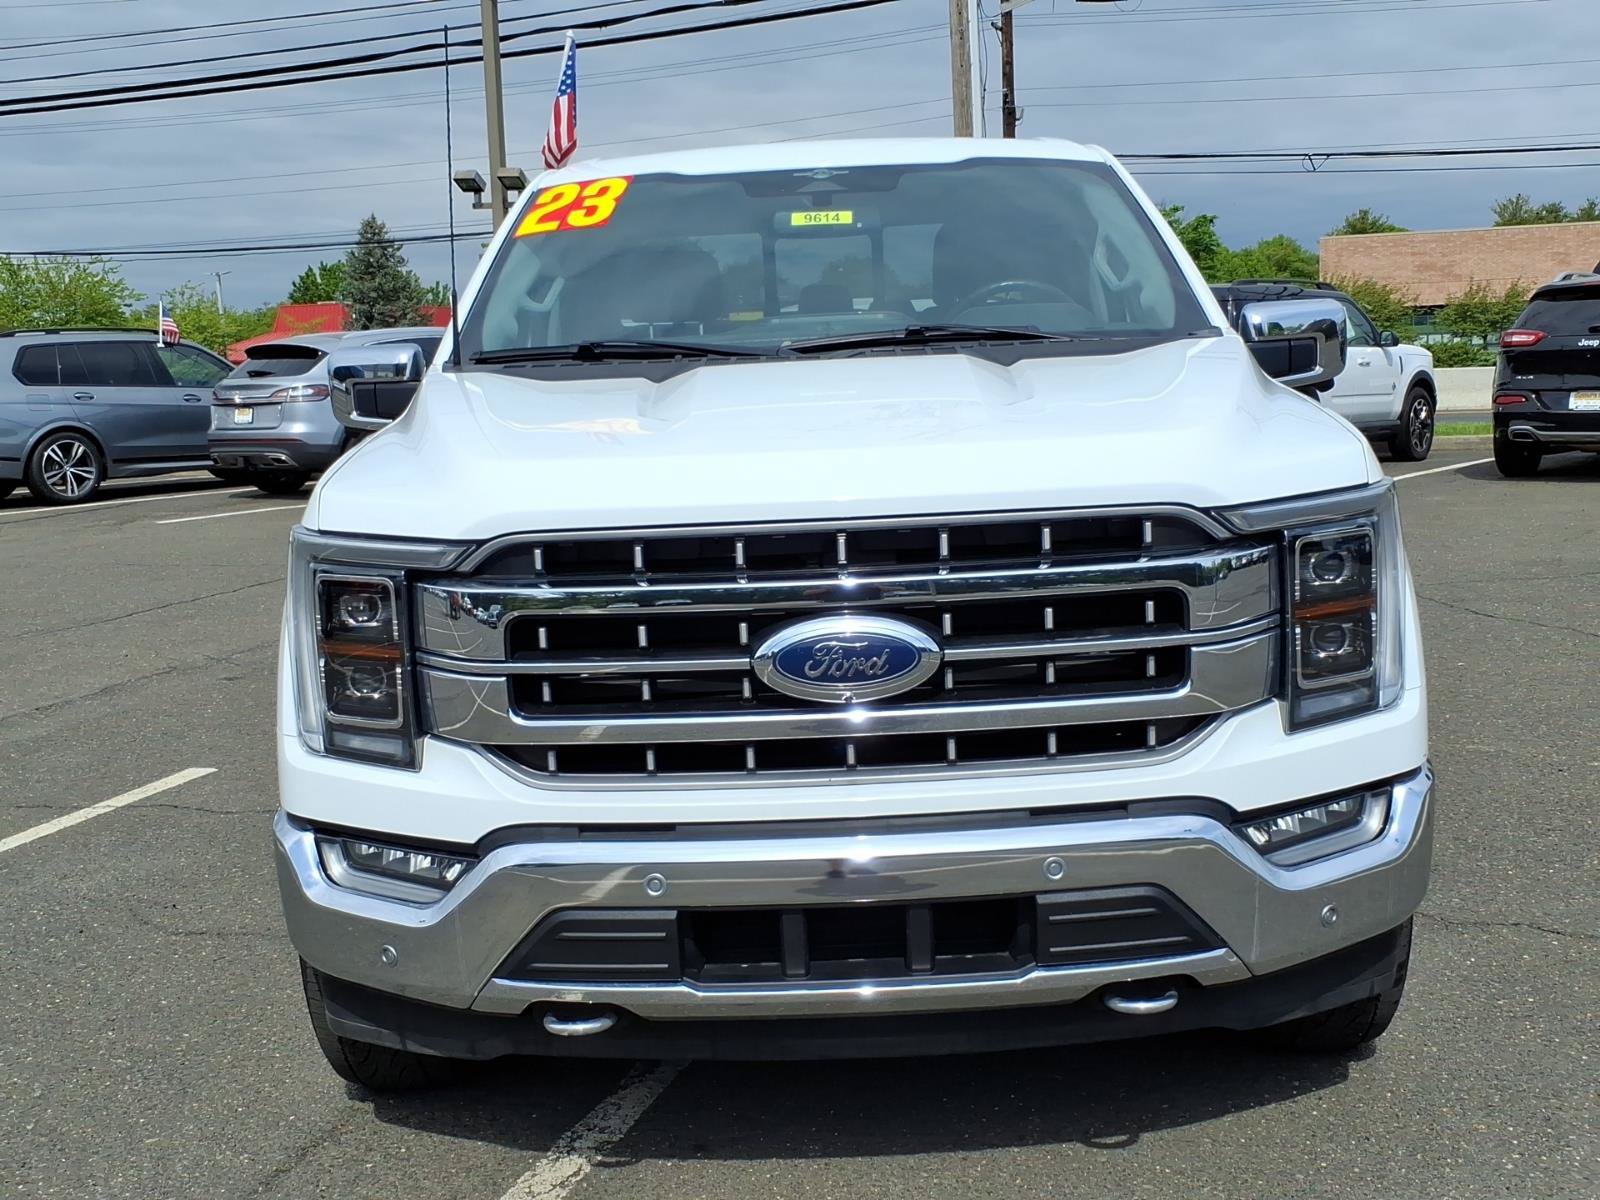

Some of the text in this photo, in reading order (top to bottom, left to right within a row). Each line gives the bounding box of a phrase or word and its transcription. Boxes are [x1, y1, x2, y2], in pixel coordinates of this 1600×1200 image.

[514, 177, 628, 237] 23
[804, 213, 841, 224] 9614
[1577, 338, 1600, 347] Jeep
[804, 641, 890, 678] Ford
